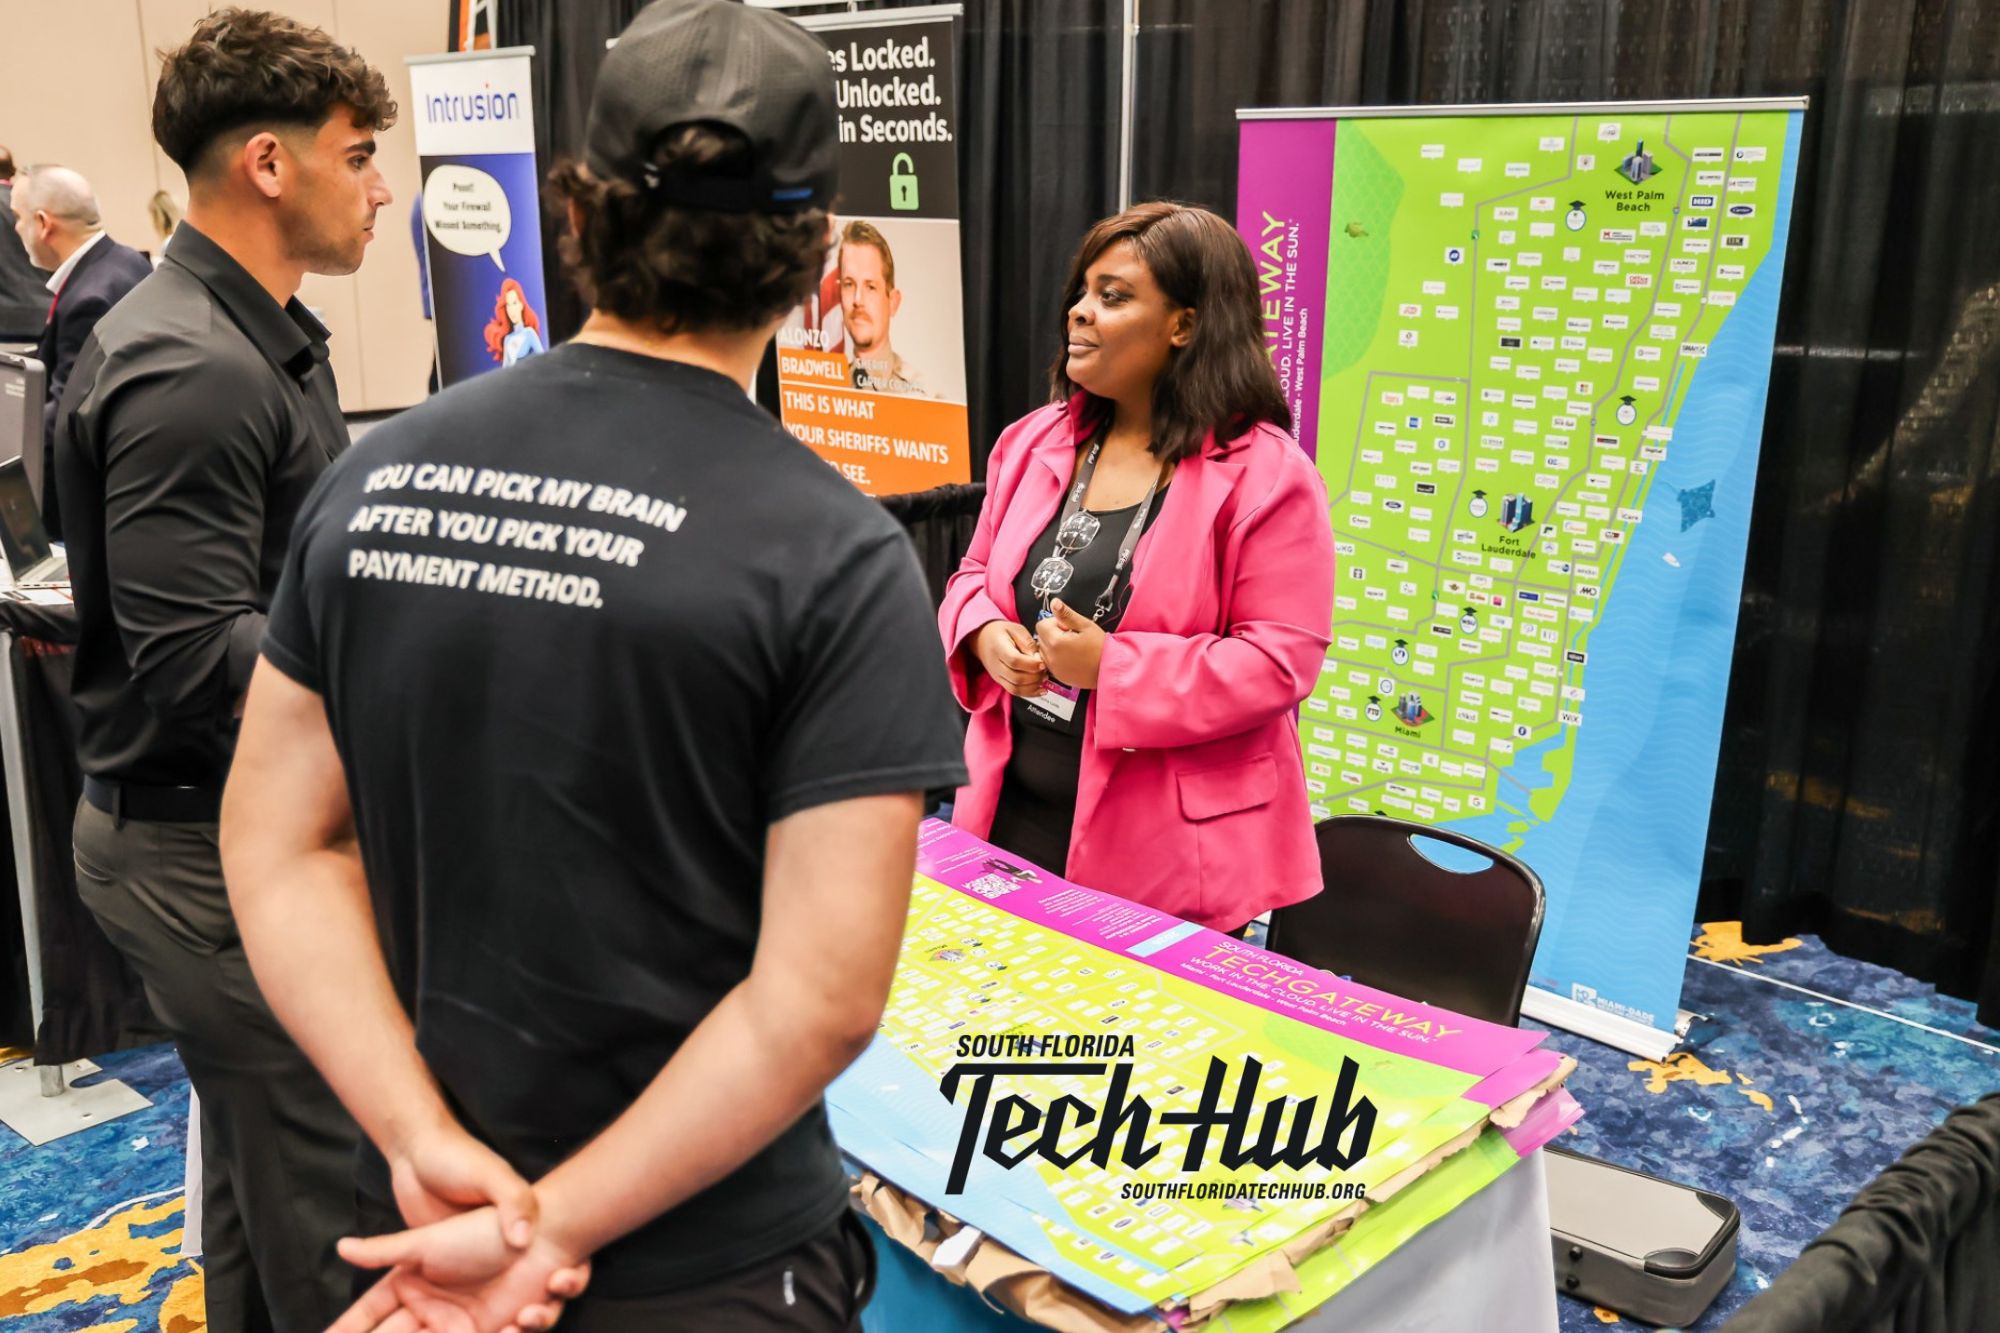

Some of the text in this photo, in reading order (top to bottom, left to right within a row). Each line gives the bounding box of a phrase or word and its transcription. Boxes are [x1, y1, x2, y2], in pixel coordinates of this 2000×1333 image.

[851, 36, 935, 71] Locked.
[426, 83, 520, 123] Intrusion
[836, 74, 941, 109] Unlocked.
[839, 112, 952, 143] in Seconds.
[1605, 190, 1665, 200] West Palm
[1616, 202, 1651, 212] Beach
[1287, 222, 1300, 258] SUN.
[1285, 262, 1297, 292] THE
[1284, 296, 1295, 312] IN
[780, 326, 829, 348] ALONZO
[1282, 316, 1294, 349] LIVE
[1297, 308, 1308, 338] Beach
[1296, 340, 1305, 364] Palm
[781, 356, 844, 380] BRADWELL
[1295, 367, 1304, 391] West
[784, 391, 875, 419] THIS IS WHAT
[786, 424, 949, 464] YOUR SHERIFFS WANTS
[363, 463, 687, 533] YOU CAN PICK MY BRAIN
[348, 505, 645, 567] AFTER YOU PICK YOUR
[1481, 543, 1536, 559] Lauderdale
[1499, 535, 1519, 546] Fort
[348, 549, 603, 609] PAYMENT METHOD.
[1394, 725, 1421, 739] Miami
[1219, 941, 1304, 976] SOUTH FLORIDA
[1190, 957, 1230, 975] WORK
[1229, 971, 1243, 980] IN
[1246, 976, 1272, 990] THE
[1319, 1004, 1351, 1018] LIVE
[1351, 1014, 1368, 1024] IN
[1370, 1020, 1398, 1034] THE
[1205, 945, 1464, 1038] TECHGATEWAY
[1319, 1012, 1347, 1026] Beach
